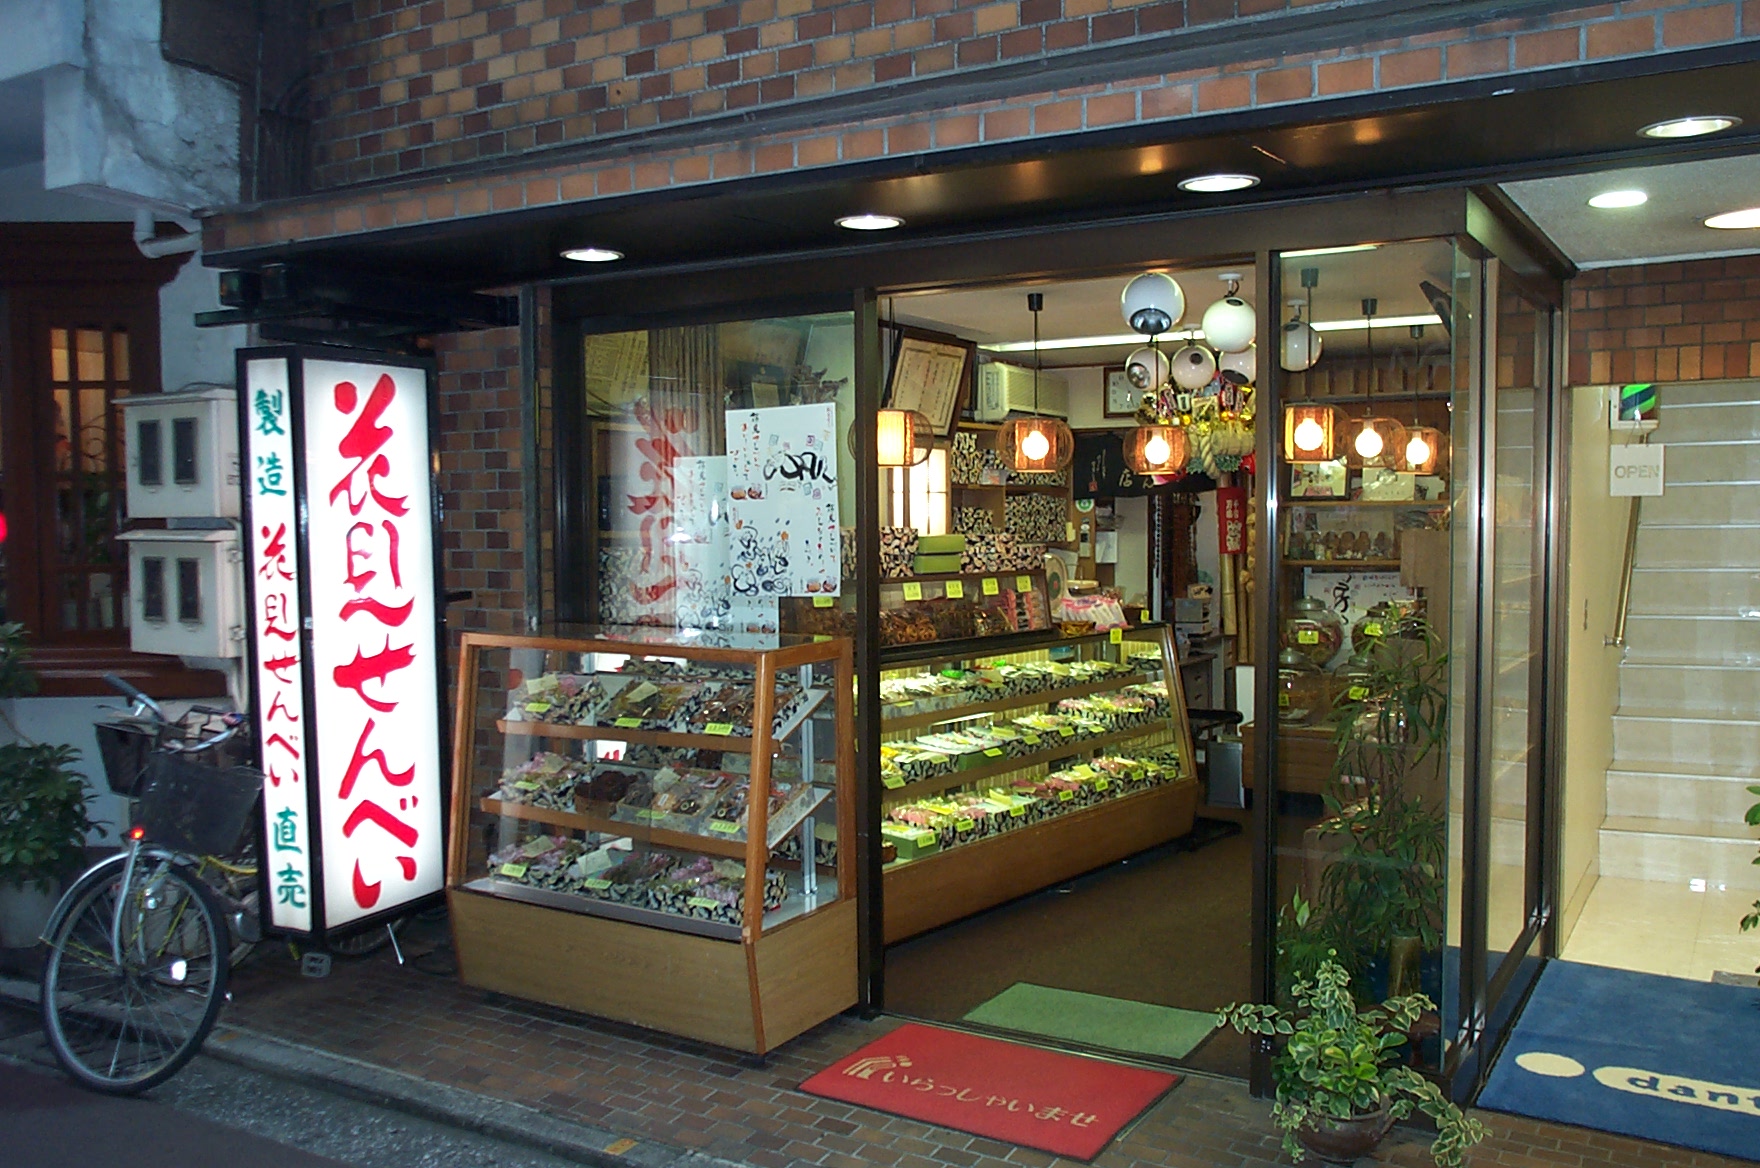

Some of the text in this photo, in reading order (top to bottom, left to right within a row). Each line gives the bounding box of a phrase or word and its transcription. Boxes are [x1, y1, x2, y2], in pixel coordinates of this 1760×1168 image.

[1614, 464, 1660, 479] OPEN
[328, 373, 419, 909] 花見せんべい
[882, 1070, 1099, 1128] いらっしゃいませ
